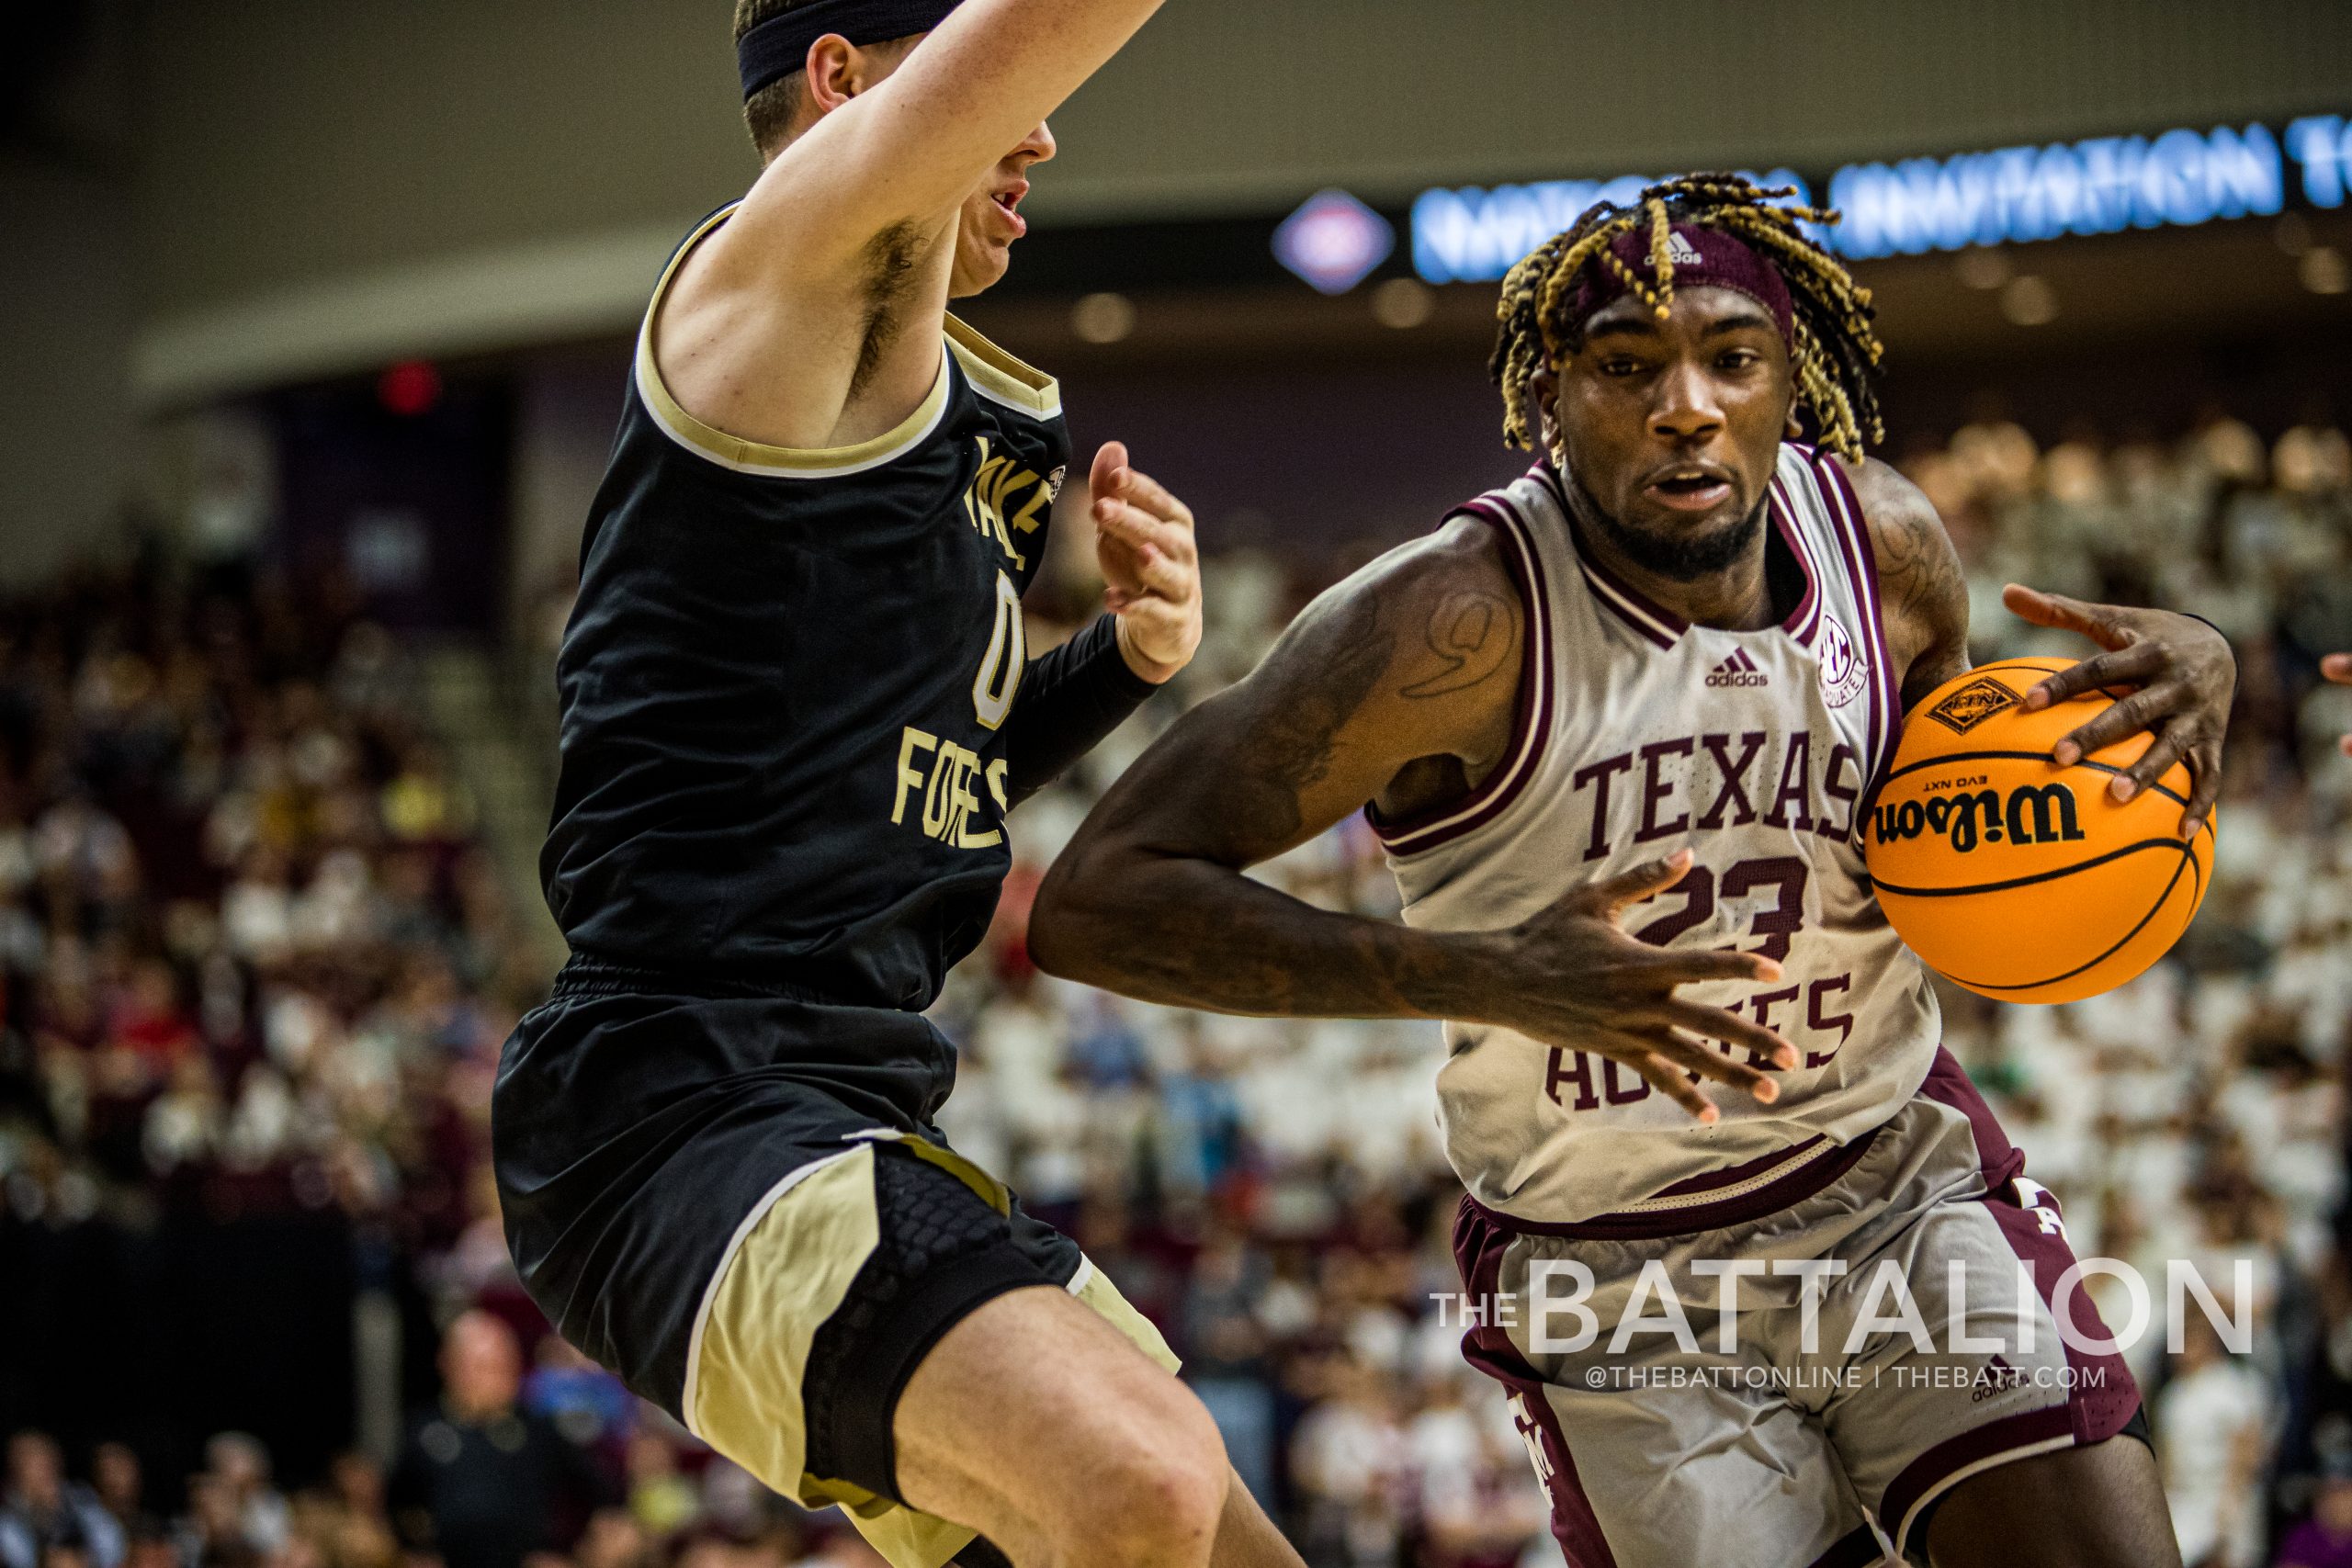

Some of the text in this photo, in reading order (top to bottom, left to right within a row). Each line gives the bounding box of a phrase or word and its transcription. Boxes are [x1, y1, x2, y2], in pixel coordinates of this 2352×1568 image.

[1643, 252, 1702, 266] adas
[972, 569, 1025, 731] 0
[1704, 671, 1769, 688] adidas
[890, 726, 1009, 850] FORES
[1574, 730, 1856, 862] TEXAS
[1874, 782, 2086, 853] Wilson
[1922, 774, 1988, 793] EVO NXT
[1633, 855, 1809, 966] 23
